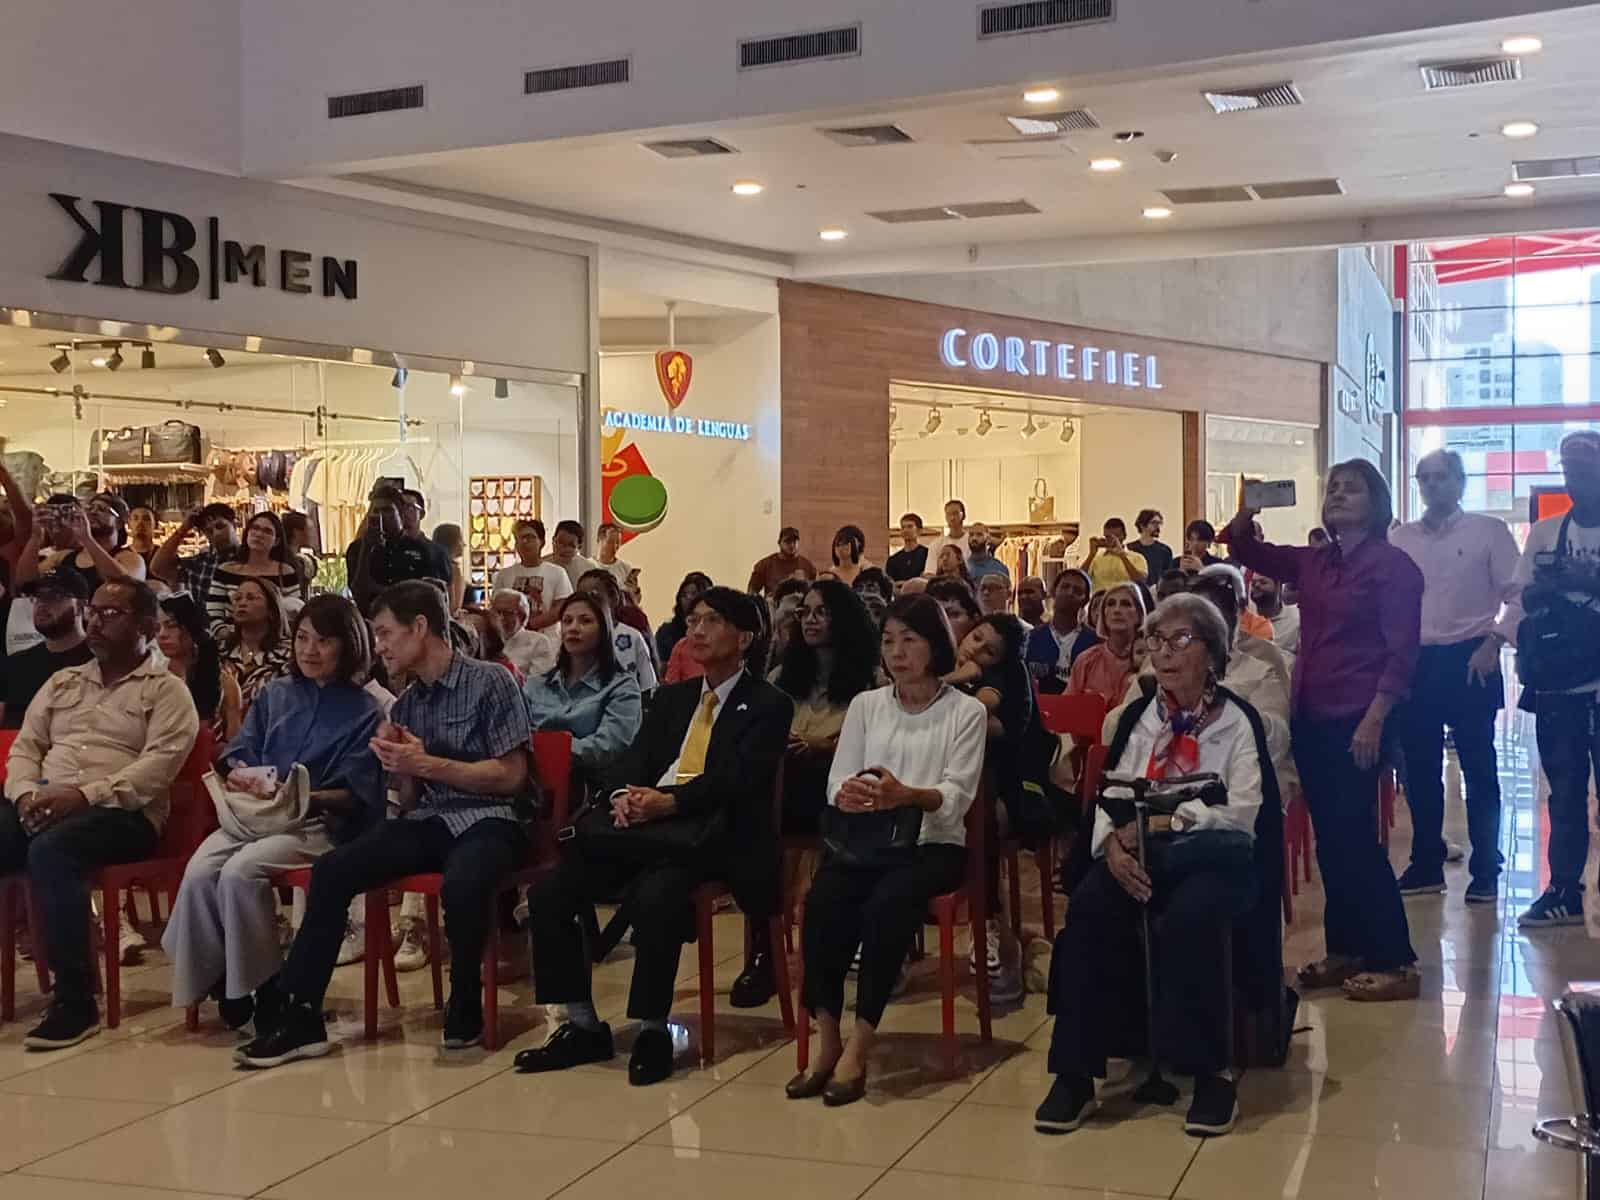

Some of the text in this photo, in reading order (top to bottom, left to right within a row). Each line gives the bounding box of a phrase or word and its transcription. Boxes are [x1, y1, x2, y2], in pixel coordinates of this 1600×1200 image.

[224, 240, 357, 300] MEN
[941, 327, 1164, 390] CORTEFIEL
[605, 410, 749, 440] ACADEMIA DE LENGUAS
